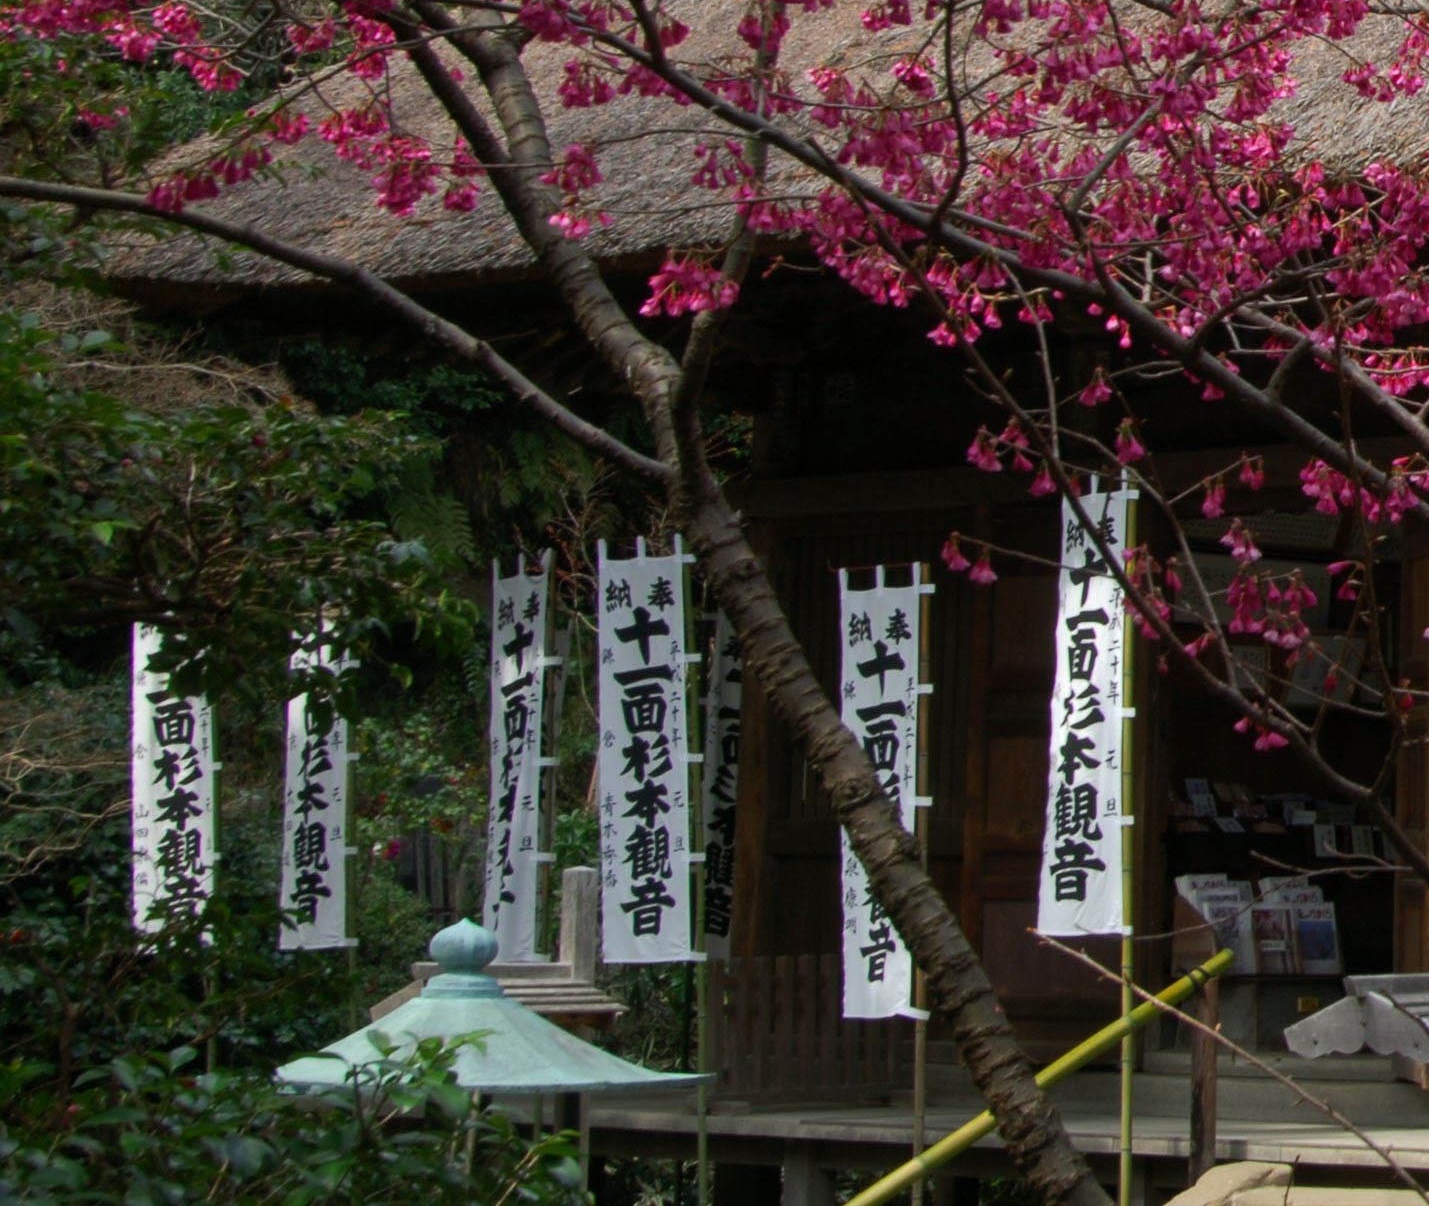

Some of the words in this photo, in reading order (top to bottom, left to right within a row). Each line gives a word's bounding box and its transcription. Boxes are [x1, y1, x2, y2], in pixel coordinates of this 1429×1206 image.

[605, 575, 676, 613] 奉納
[848, 608, 913, 647] 奉納
[1050, 548, 1111, 903] 十一面杉本観音
[613, 606, 677, 938] 十一面杉本観音
[1103, 749, 1119, 817] 元旦
[518, 794, 536, 854] 元旦
[671, 792, 686, 854] 元旦
